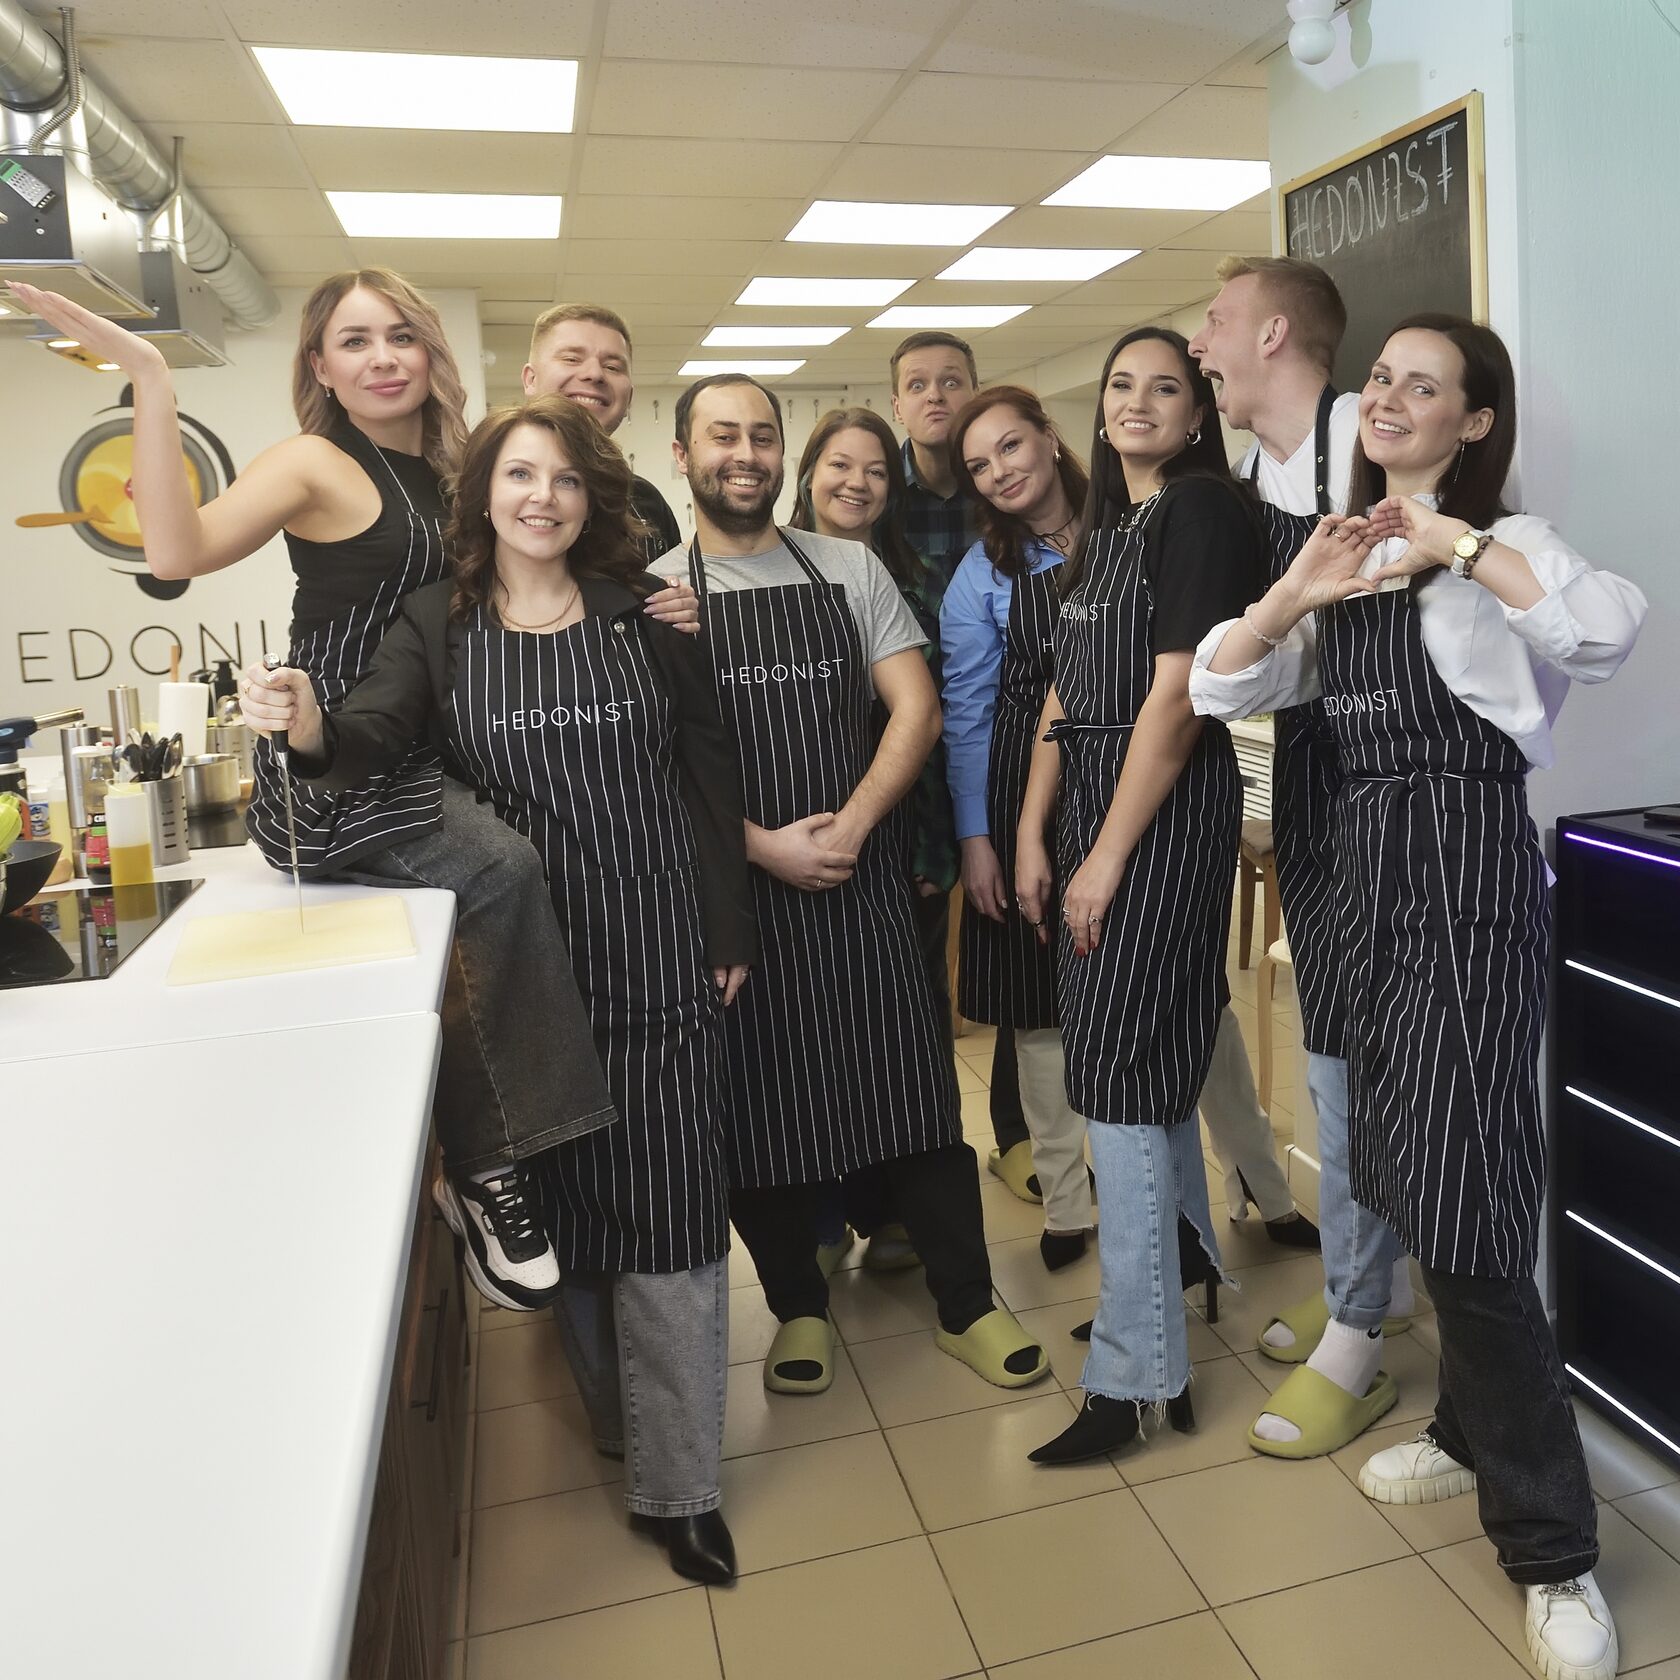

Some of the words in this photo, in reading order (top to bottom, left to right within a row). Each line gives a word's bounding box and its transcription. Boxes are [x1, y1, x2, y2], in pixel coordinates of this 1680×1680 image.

[1289, 121, 1458, 261] HEDONIST
[722, 658, 844, 686] HEDONIST
[493, 700, 635, 733] HEDONIST
[1324, 689, 1398, 716] EDONIST
